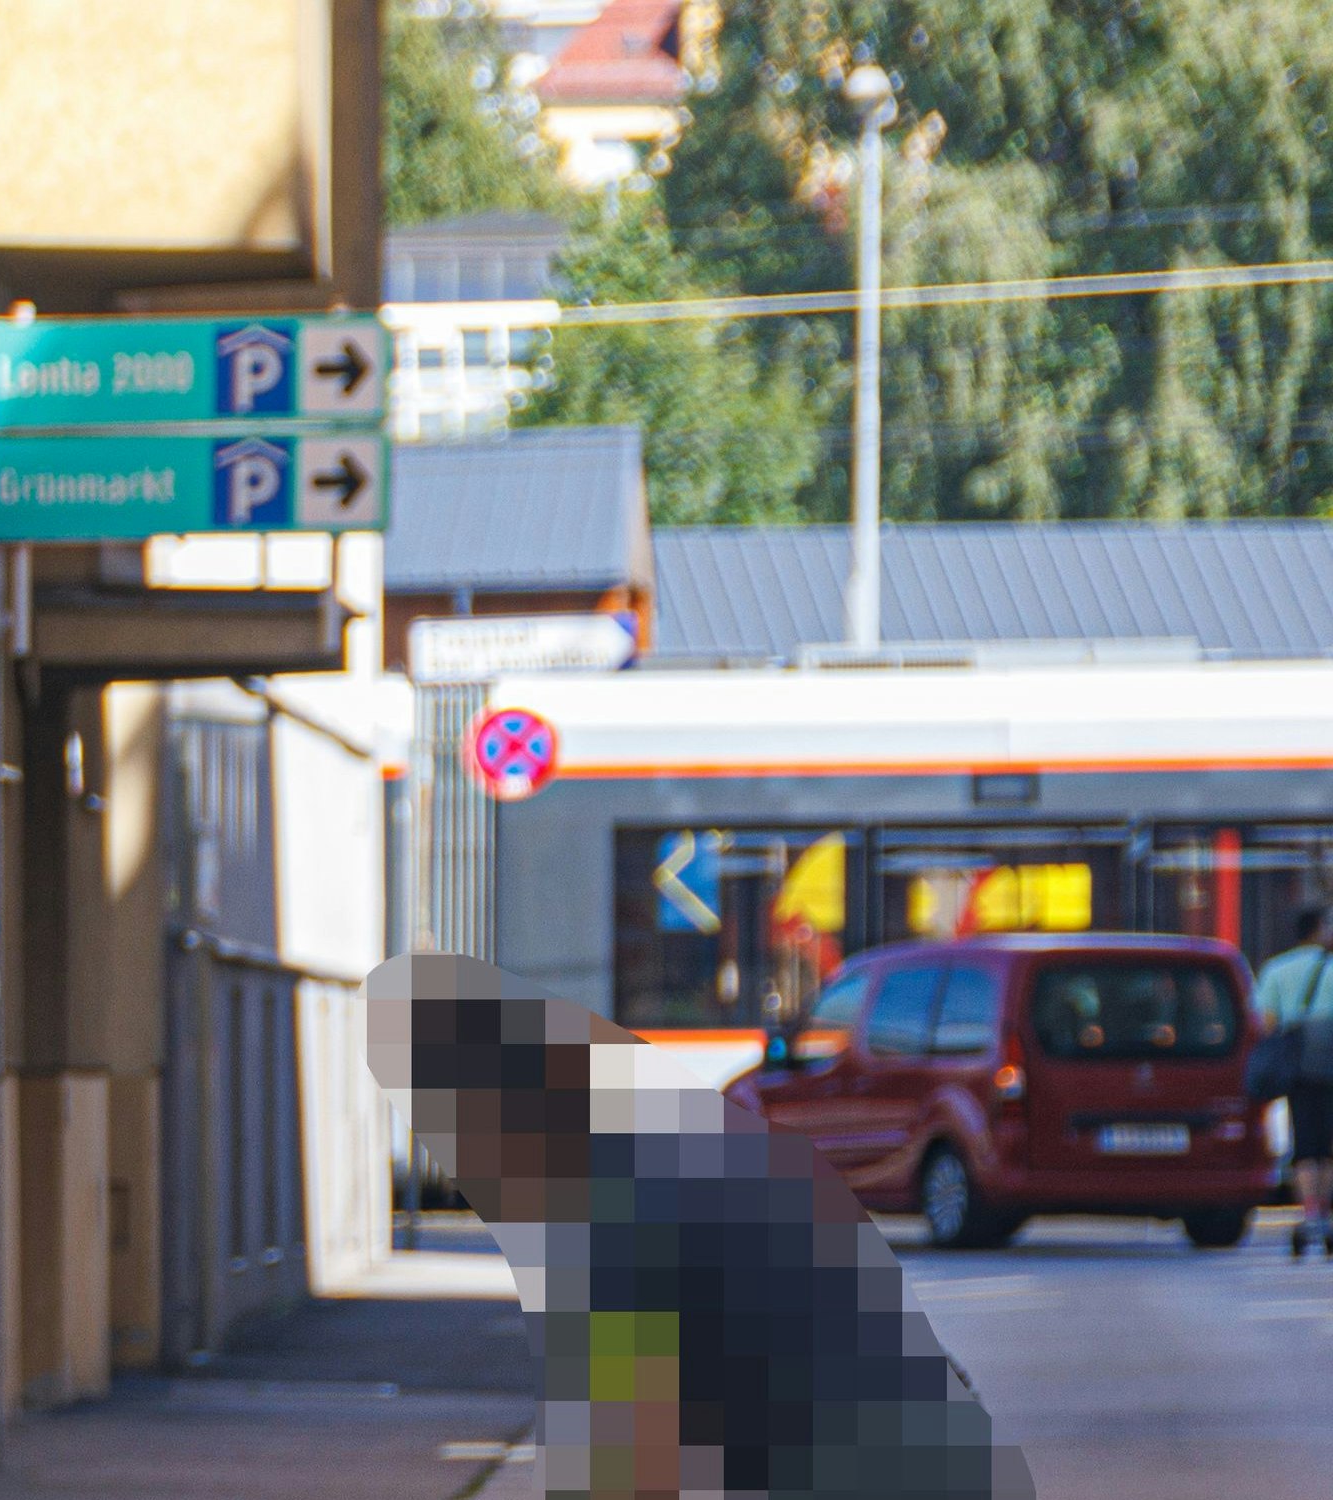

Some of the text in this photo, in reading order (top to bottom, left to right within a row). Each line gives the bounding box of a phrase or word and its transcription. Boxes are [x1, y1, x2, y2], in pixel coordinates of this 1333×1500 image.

[112, 350, 195, 396] 2000
[232, 342, 283, 413] P
[230, 453, 282, 524] P
